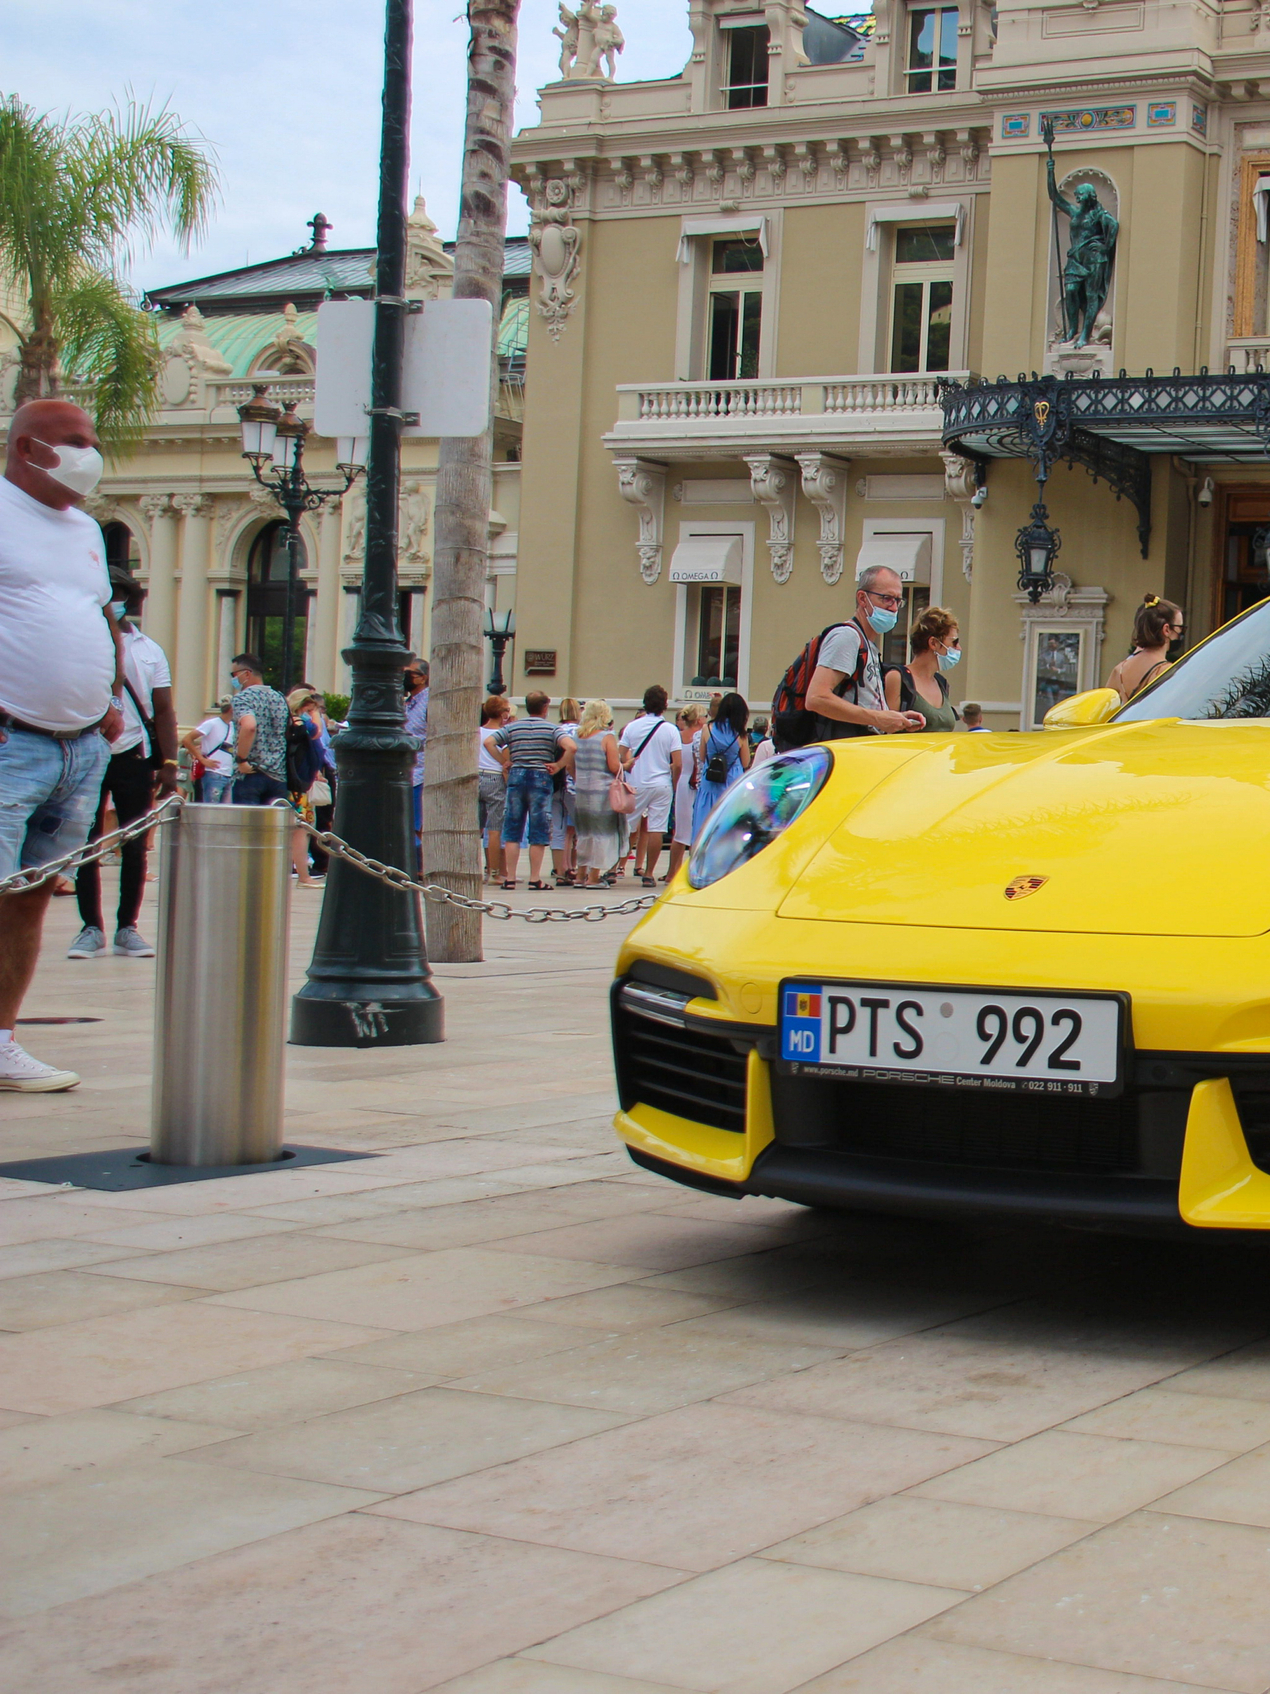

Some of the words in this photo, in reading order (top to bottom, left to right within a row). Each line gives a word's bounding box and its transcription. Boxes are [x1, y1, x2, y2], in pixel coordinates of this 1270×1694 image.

[681, 572, 709, 580] OMEGA
[789, 1029, 815, 1053] MD
[827, 994, 925, 1060] PTS
[975, 1003, 1083, 1071] 992
[803, 1064, 859, 1078] www.porsche.md
[862, 1069, 955, 1084] PORSCHE
[956, 1076, 982, 1087] Center
[983, 1078, 1016, 1089] Moldova
[1028, 1081, 1045, 1091] 022
